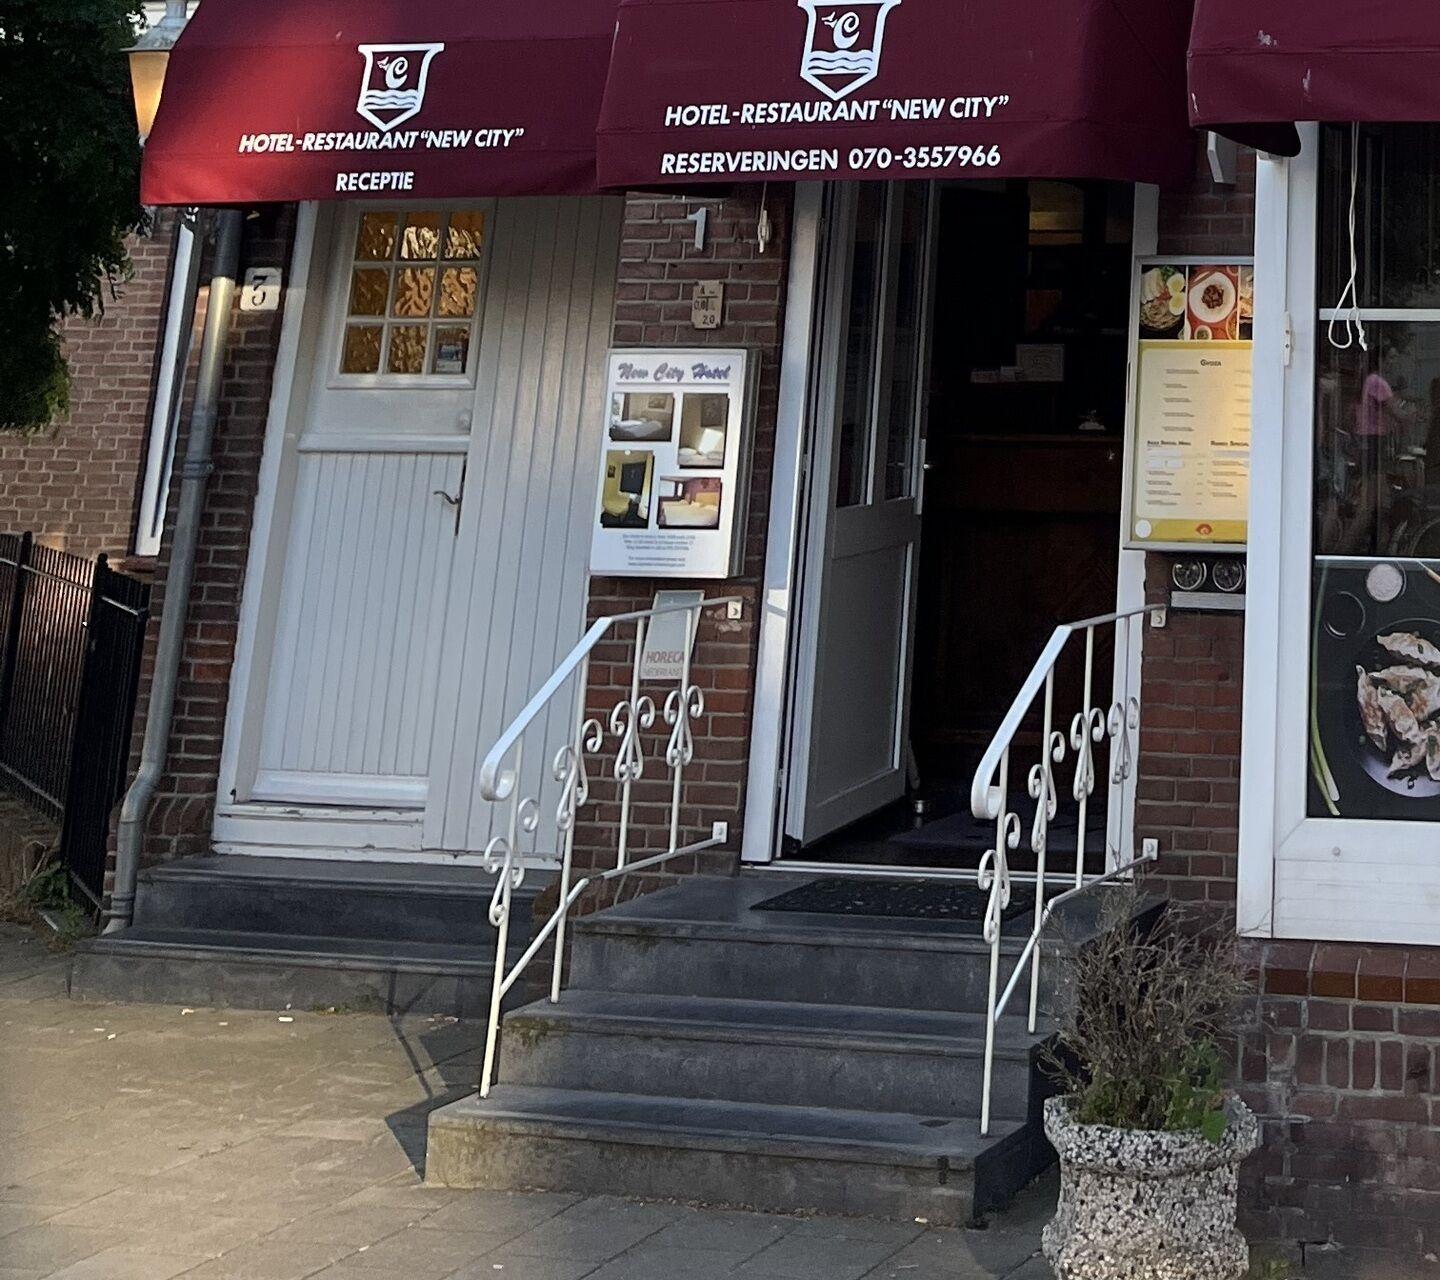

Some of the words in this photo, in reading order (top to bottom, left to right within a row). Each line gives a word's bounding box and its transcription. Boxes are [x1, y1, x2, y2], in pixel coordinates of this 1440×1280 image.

[665, 99, 880, 127] HOTEL-RESTAURANT
[238, 130, 419, 153] HOTEL-RESTAURANT
[661, 148, 838, 174] RESERVERINGEN
[848, 145, 1001, 170] 070-3557966
[335, 171, 414, 191] RECEPTIE
[687, 207, 707, 251] 1
[251, 275, 269, 306] 3
[618, 362, 648, 380] New
[653, 362, 684, 382] City
[691, 362, 731, 379] Hotel
